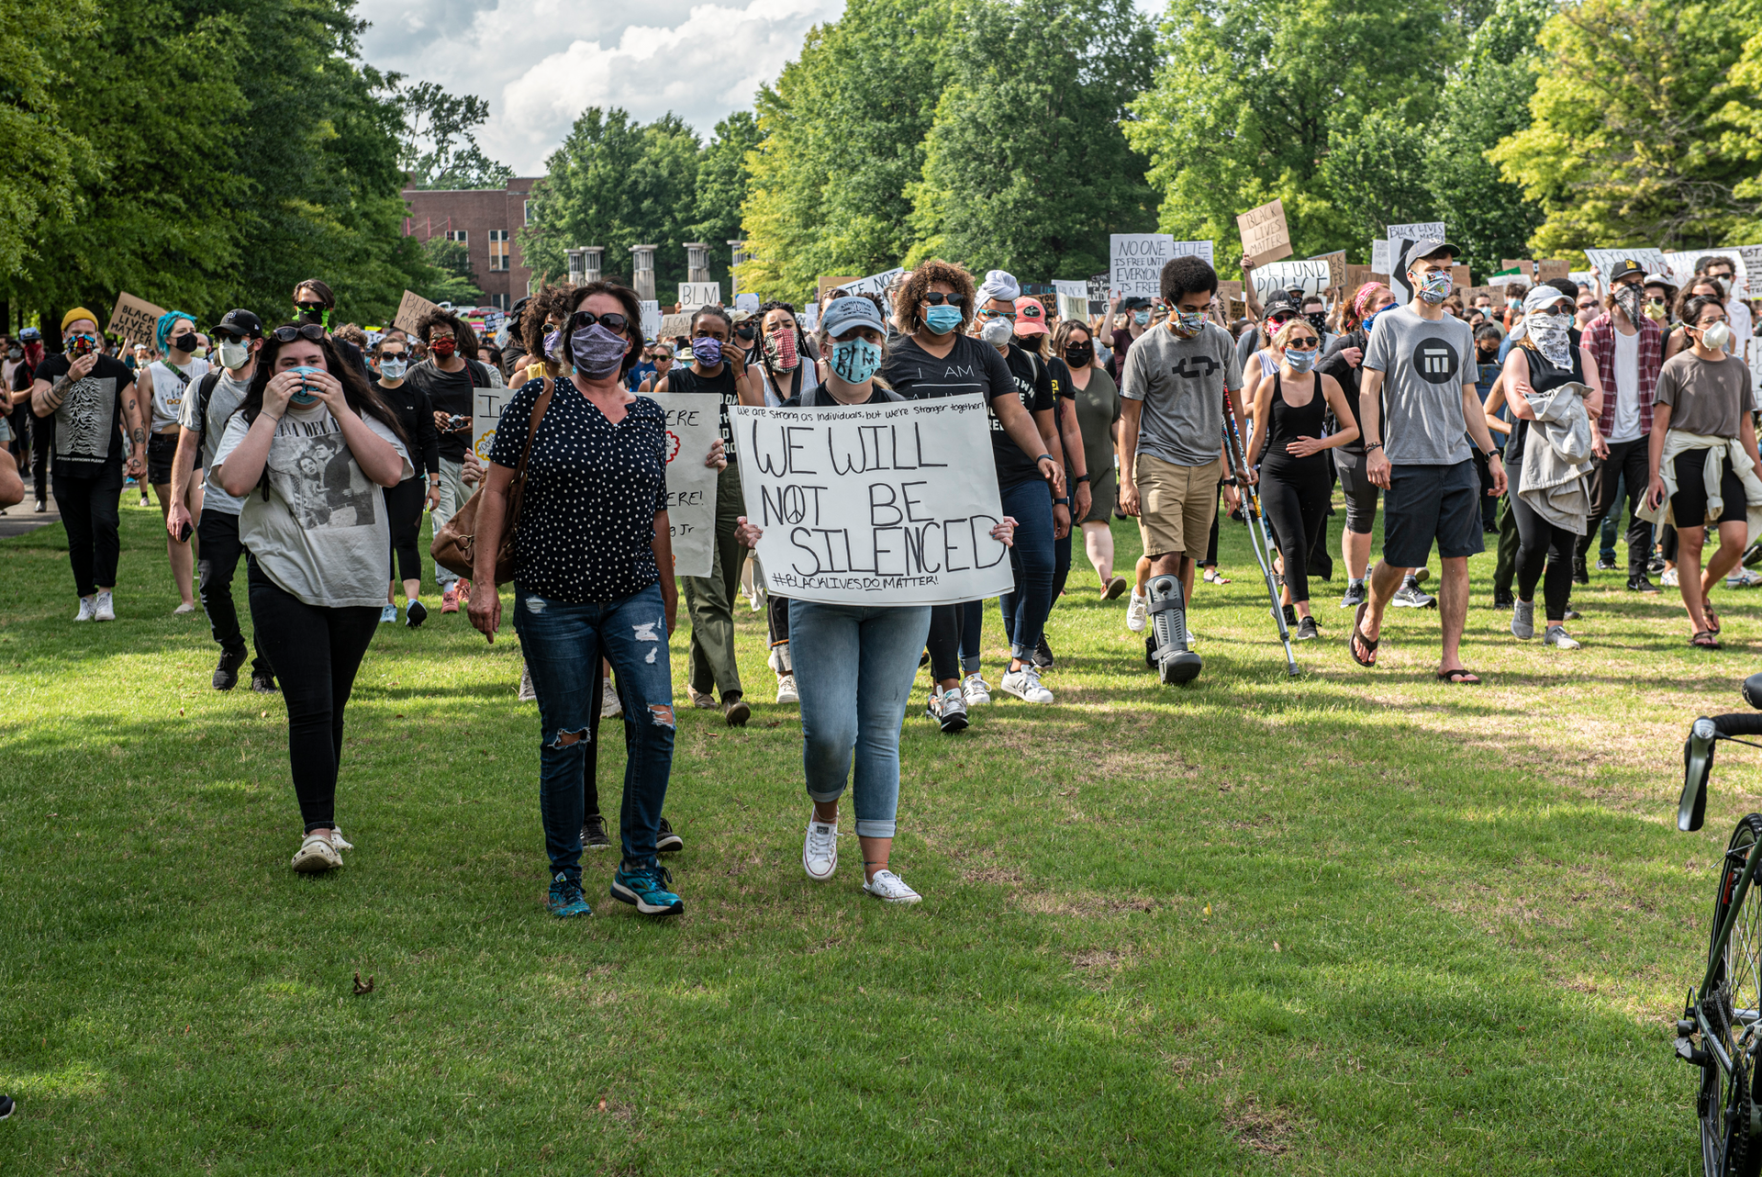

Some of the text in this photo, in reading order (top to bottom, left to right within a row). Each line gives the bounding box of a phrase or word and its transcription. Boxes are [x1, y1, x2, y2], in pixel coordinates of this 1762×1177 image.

[1246, 205, 1278, 229] BLACK
[1254, 219, 1282, 241] LIVES
[1389, 223, 1444, 238] BLACK LIVES
[1118, 240, 1167, 257] NO ONE
[1250, 234, 1283, 256] MATTER
[1127, 258, 1146, 267] FREE
[683, 285, 717, 306] BLM
[1120, 283, 1132, 293] IS
[119, 315, 153, 335] LIVES
[122, 305, 156, 325] BLACK
[111, 322, 153, 346] MATTER
[944, 364, 975, 378] AM
[737, 407, 750, 416] We
[752, 408, 766, 417] are
[801, 413, 813, 421] as
[866, 410, 881, 419] but
[950, 401, 984, 414] together!
[302, 421, 330, 437] DEL
[752, 419, 949, 478] WE WILL
[761, 481, 935, 527] NOT BE
[680, 523, 695, 536] Jr
[790, 514, 1007, 577] SILENCED
